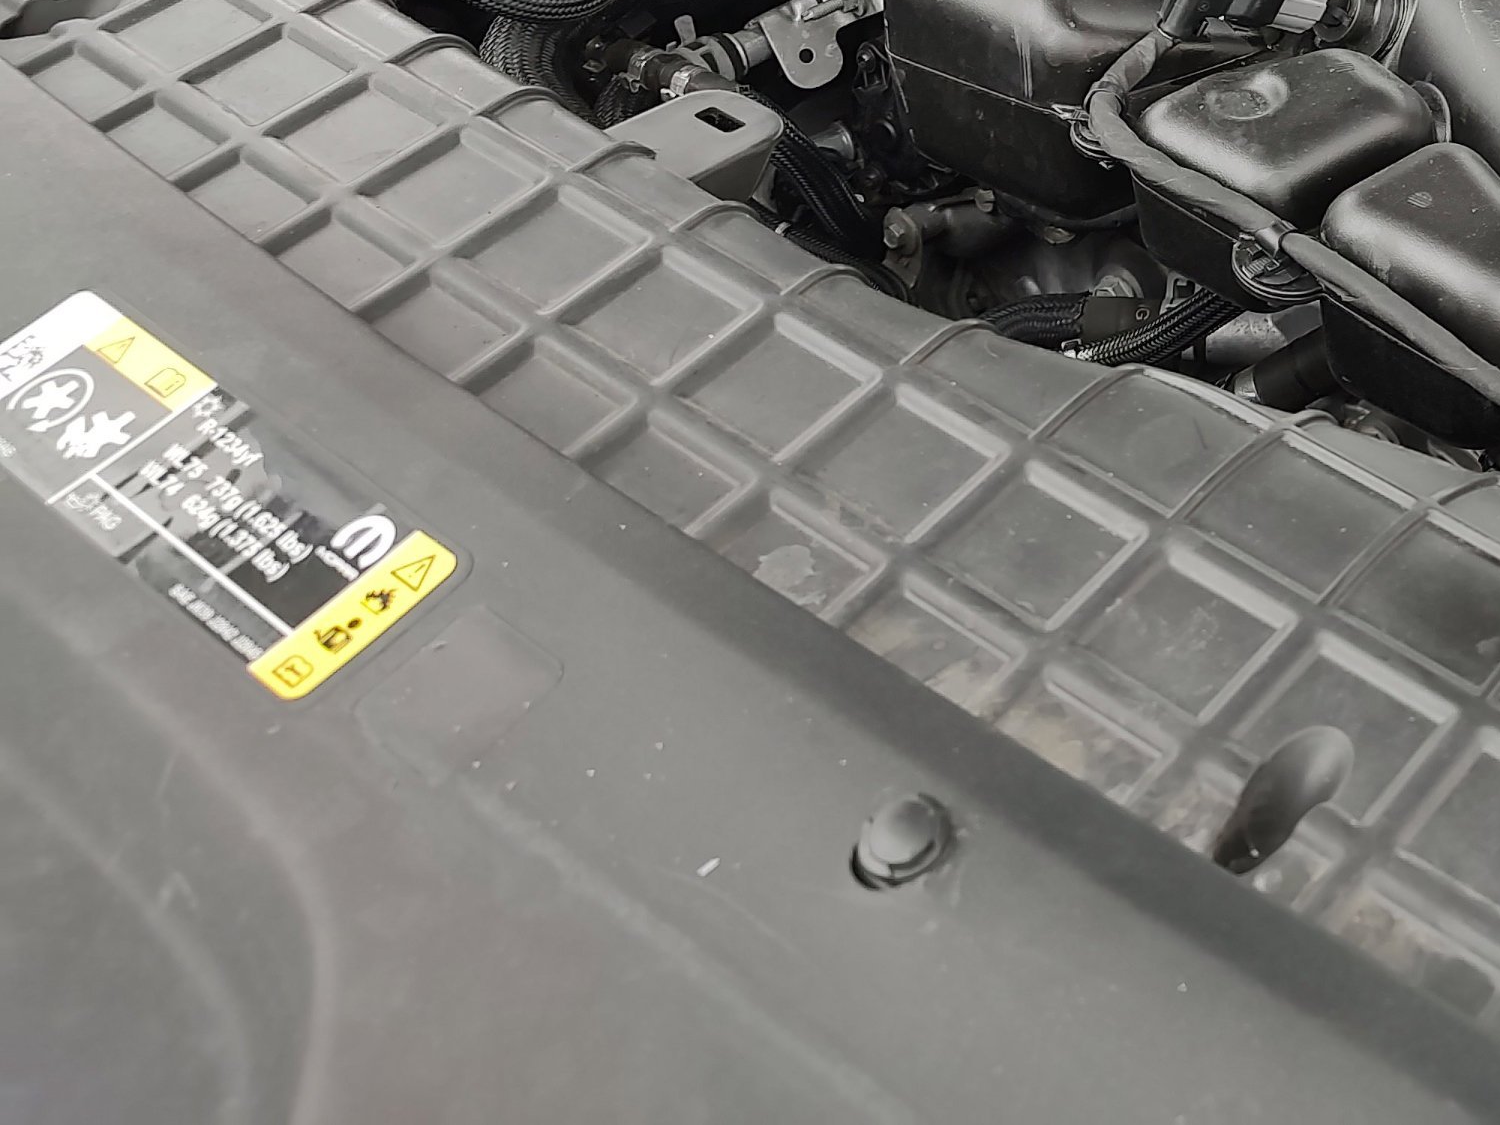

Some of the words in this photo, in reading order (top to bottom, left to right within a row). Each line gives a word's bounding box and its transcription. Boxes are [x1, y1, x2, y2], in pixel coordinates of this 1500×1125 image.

[197, 418, 264, 467] R-1234yf
[205, 475, 244, 512] 737g
[275, 530, 314, 565] lbs)
[251, 547, 291, 583] lbs)
